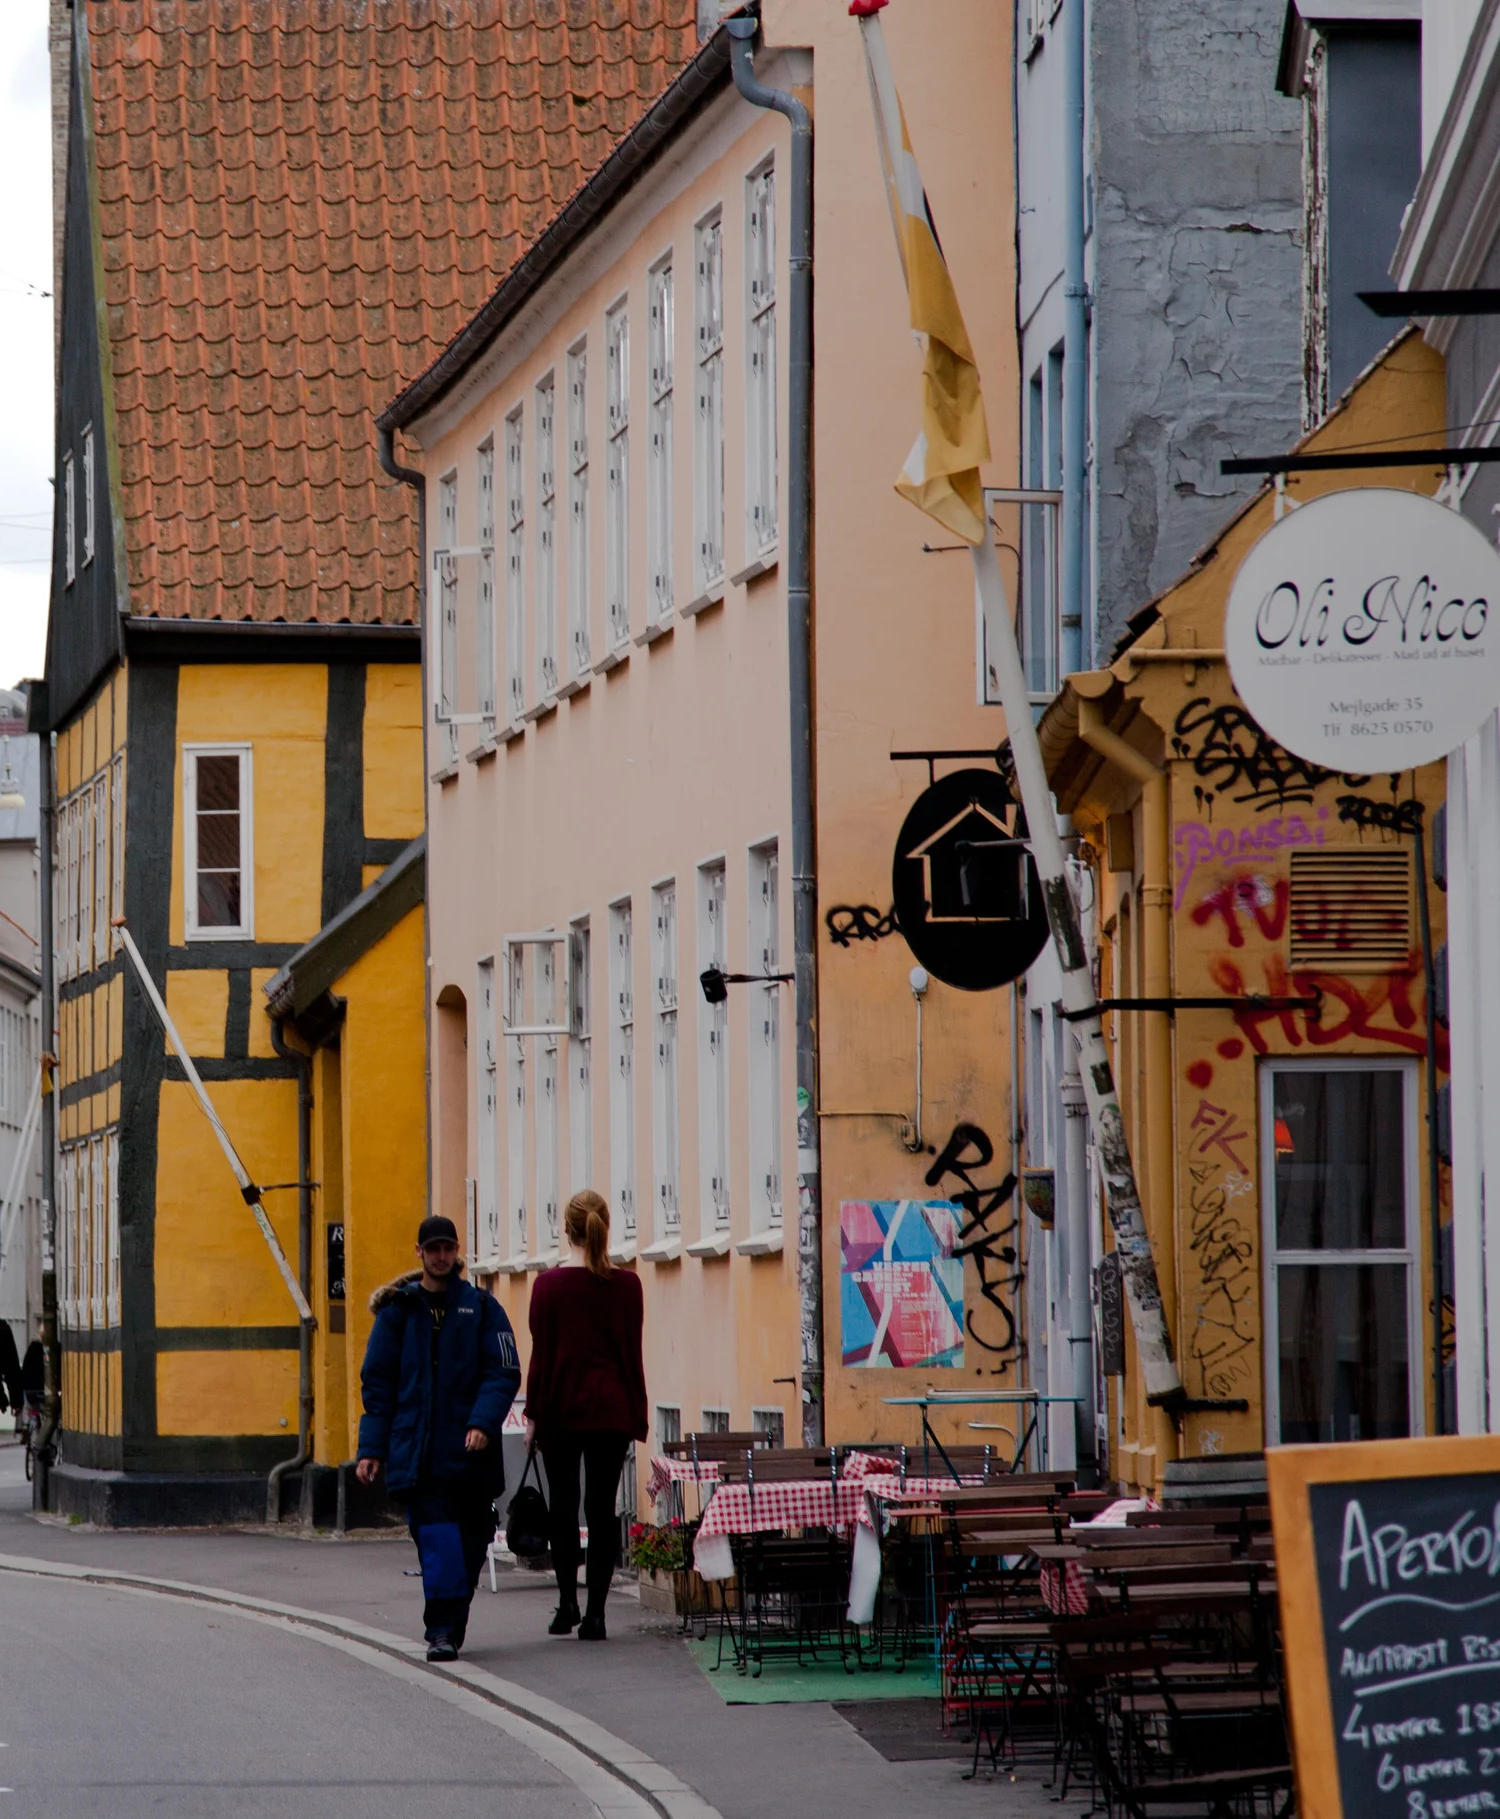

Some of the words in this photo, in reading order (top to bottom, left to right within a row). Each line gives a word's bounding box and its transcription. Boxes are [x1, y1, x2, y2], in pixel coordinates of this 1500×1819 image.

[1256, 577, 1334, 650] Oli
[1342, 574, 1489, 646] Nico
[1329, 698, 1400, 717] Mejlgade
[1403, 697, 1424, 711] 35
[1350, 721, 1389, 736] 8625
[1393, 720, 1434, 734] 0570
[1341, 1702, 1370, 1749] 4
[1376, 1752, 1400, 1792] 6
